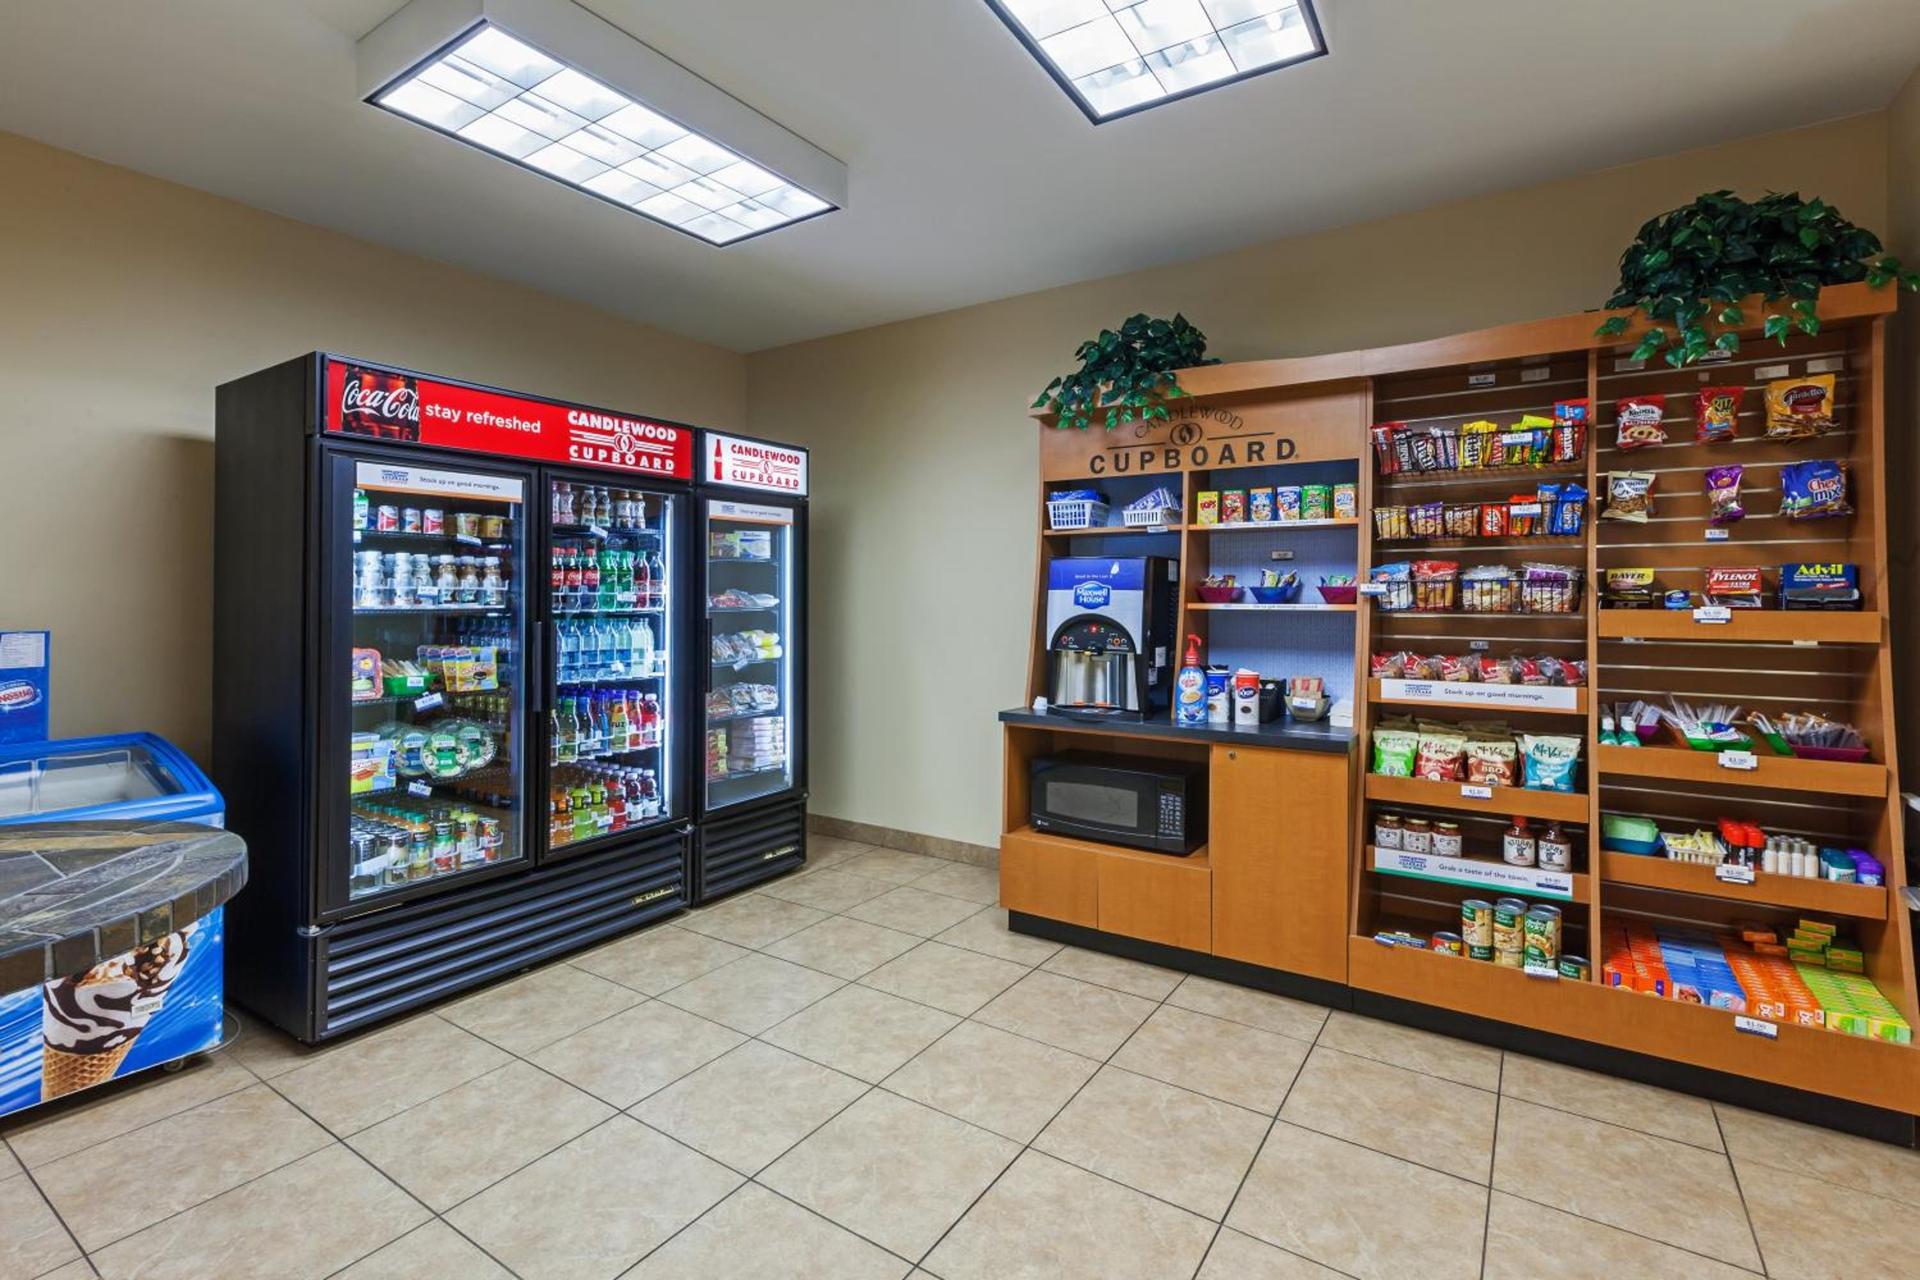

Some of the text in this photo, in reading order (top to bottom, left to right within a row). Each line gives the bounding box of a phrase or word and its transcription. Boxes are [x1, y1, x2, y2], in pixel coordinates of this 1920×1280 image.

[425, 404, 541, 433] stay refreshed
[567, 411, 677, 442] CANDLEWOOD
[569, 445, 675, 471] CUPBOARD
[730, 444, 801, 465] CANDLEWOOD
[1089, 438, 1296, 475] CUPBOARD
[731, 469, 800, 488] CUPBOARD
[1808, 476, 1840, 492] Chex
[1814, 485, 1841, 502] mix
[1610, 572, 1646, 580] BAYER
[1712, 571, 1757, 581] TYLENOL
[1796, 563, 1843, 575] Advil
[1076, 587, 1108, 597] Maxwell
[1079, 595, 1105, 604] House
[1481, 765, 1505, 774] BBQ
[1464, 867, 1483, 876] taste
